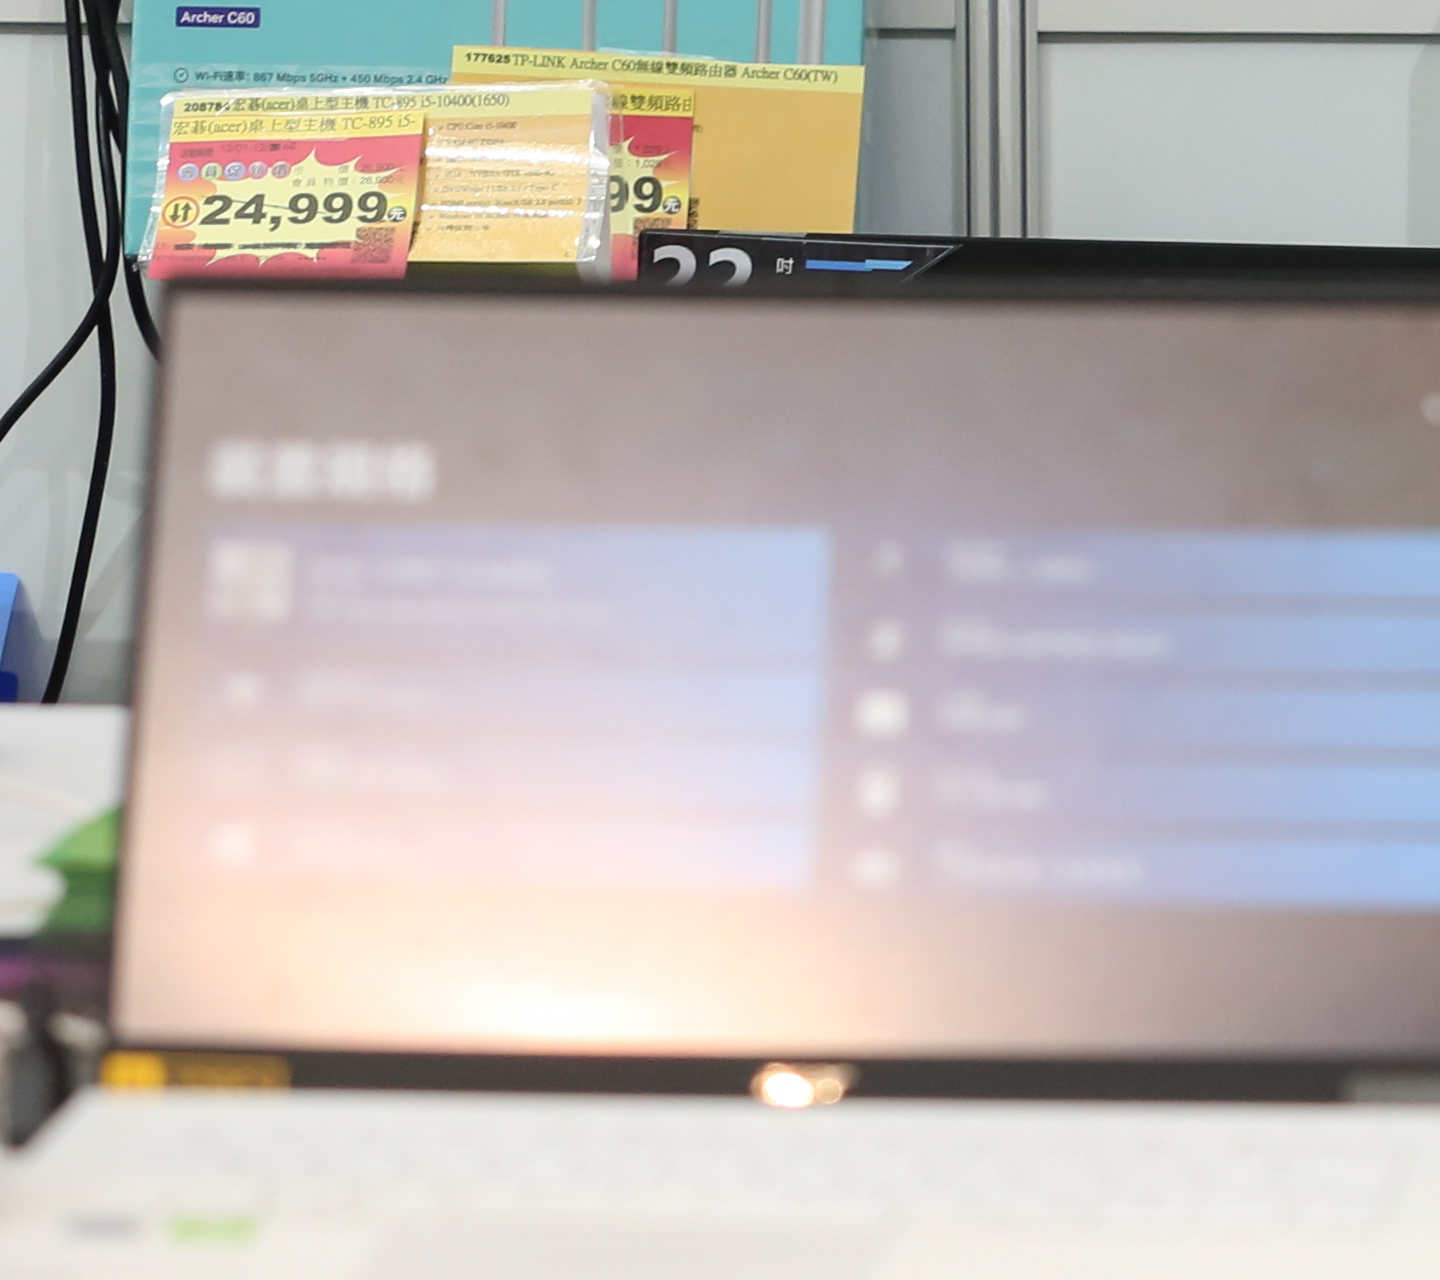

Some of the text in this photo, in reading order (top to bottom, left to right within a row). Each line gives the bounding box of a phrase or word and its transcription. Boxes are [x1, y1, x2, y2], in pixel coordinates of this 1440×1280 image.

[180, 10, 255, 25] Archer C60
[464, 52, 511, 65] 177625
[512, 53, 566, 70] TP-LINK
[569, 56, 609, 71] Archer
[740, 65, 781, 81] Archer
[783, 66, 839, 85] C60(TW)
[276, 72, 307, 84] Mbps
[309, 73, 339, 84] 5GHz
[350, 74, 371, 84] 450
[373, 74, 404, 85] Mbps
[425, 74, 449, 85] GHz
[421, 94, 510, 109] i5-10400(1650)
[172, 115, 338, 137] 宏碁(acer)桌上型主機
[341, 115, 394, 131] TC-895
[197, 190, 407, 232] 24,999 元
[662, 195, 681, 214] 元
